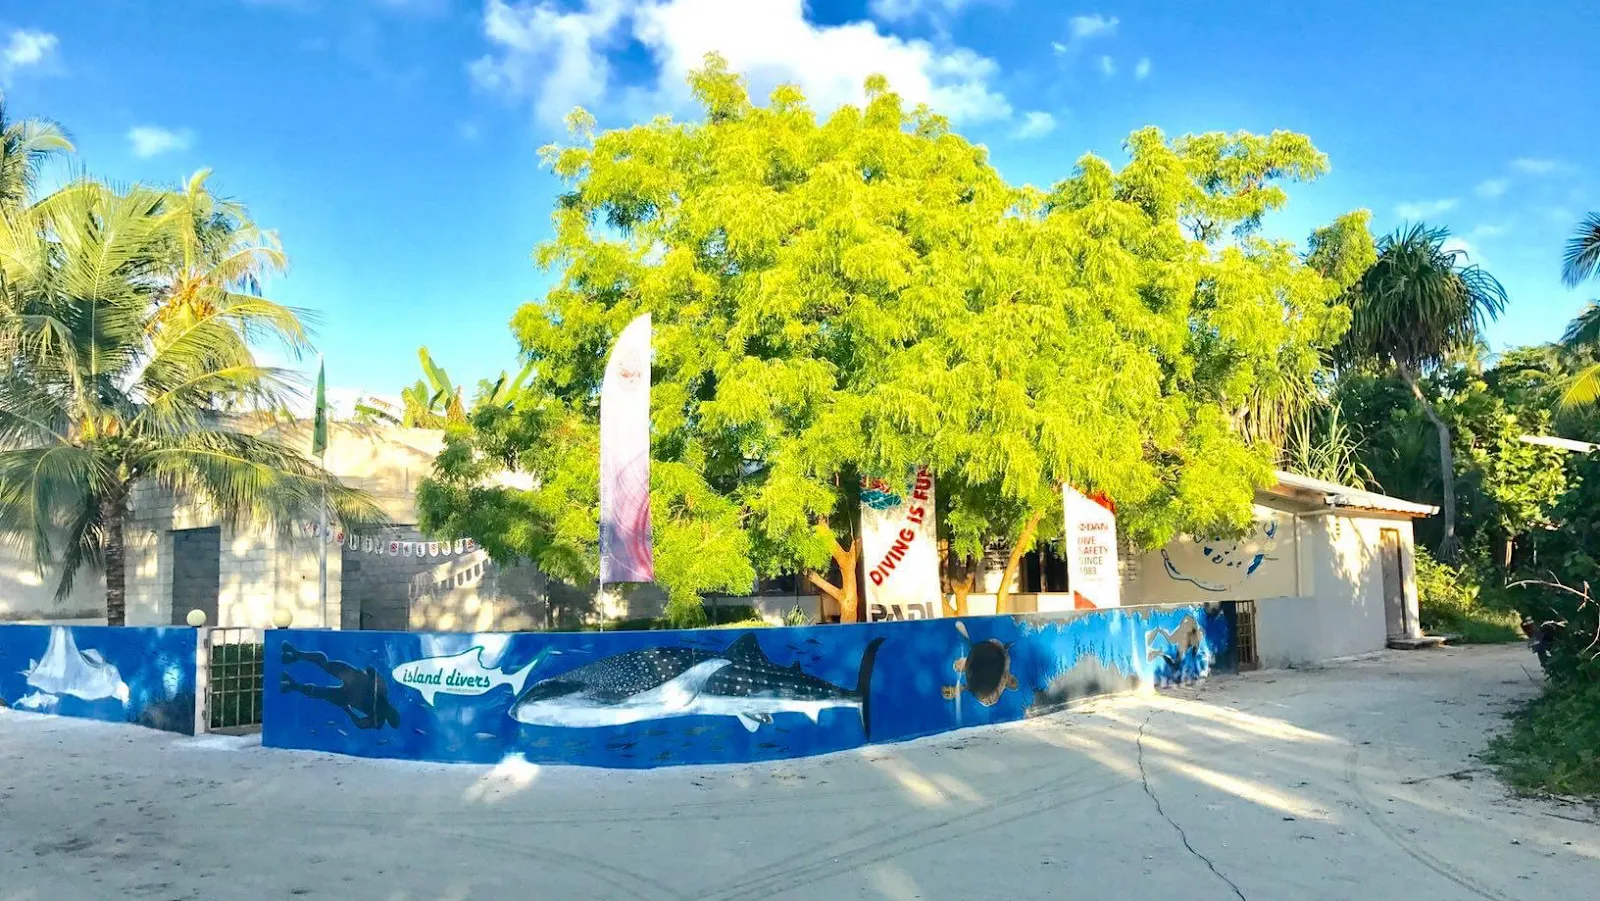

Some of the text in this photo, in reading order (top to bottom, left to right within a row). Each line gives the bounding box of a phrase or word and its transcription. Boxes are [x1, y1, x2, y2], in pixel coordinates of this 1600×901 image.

[869, 528, 915, 586] DIVING
[906, 505, 925, 525] IS
[1077, 536, 1096, 545] DIVE
[1078, 546, 1108, 555] SAFETY
[1079, 556, 1103, 566] SINCE
[871, 601, 935, 622] PADI
[402, 666, 490, 688] island divers
